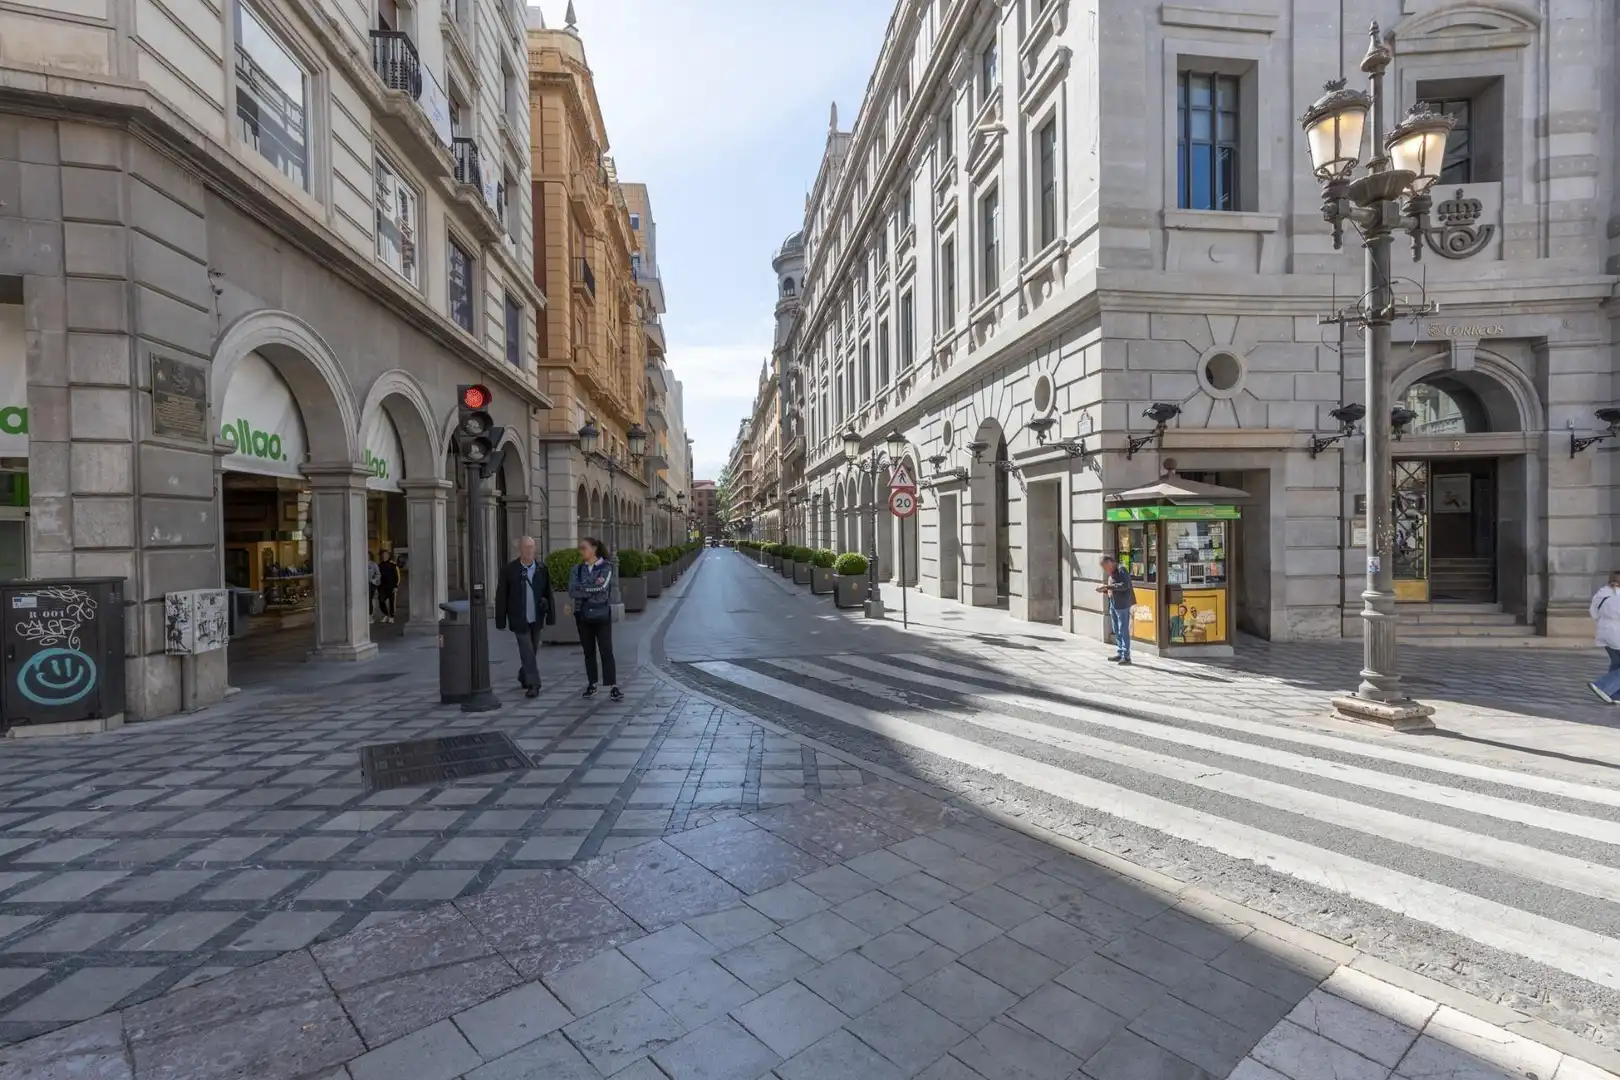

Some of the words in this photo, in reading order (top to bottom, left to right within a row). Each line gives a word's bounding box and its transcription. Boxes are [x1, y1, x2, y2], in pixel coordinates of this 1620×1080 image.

[1444, 324, 1505, 337] CORREOS
[1453, 440, 1461, 451] 2
[896, 498, 911, 508] 20
[29, 610, 37, 619] R
[42, 610, 65, 618] 001
